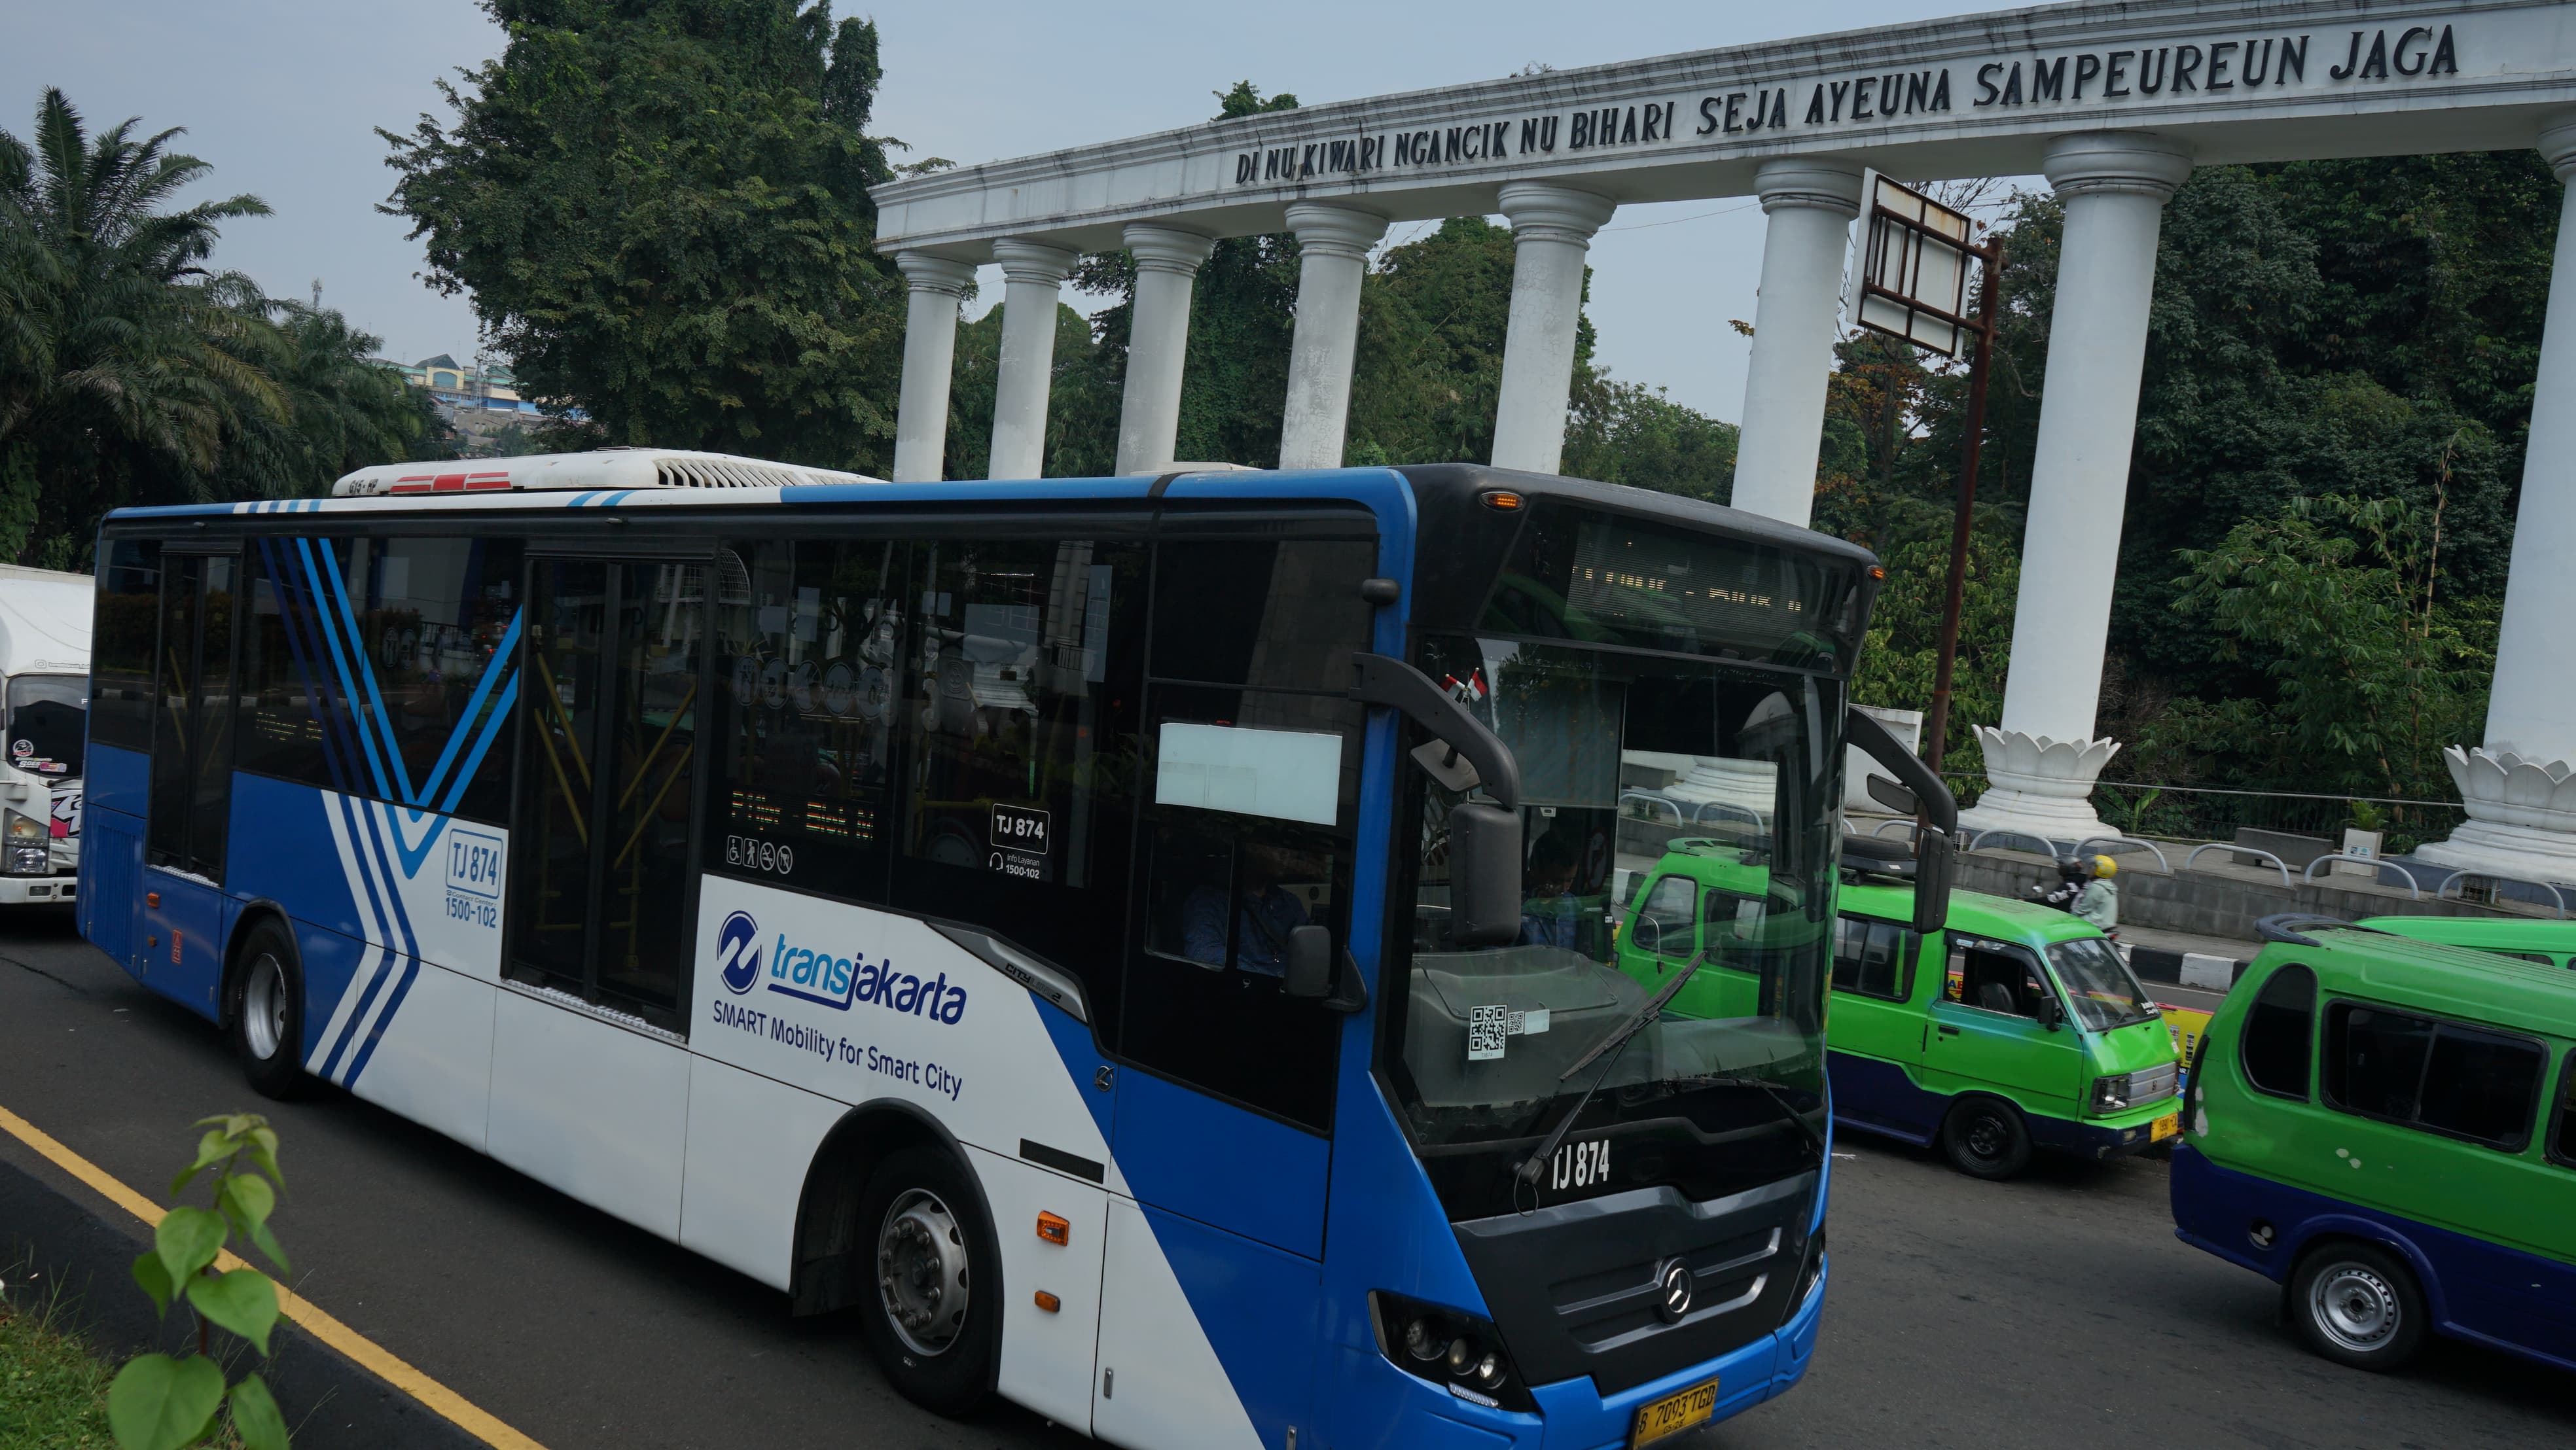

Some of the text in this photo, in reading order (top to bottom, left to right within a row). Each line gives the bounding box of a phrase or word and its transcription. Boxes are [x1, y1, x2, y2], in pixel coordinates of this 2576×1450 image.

[1236, 24, 2460, 184] DI NU KIWARI NGANCIK NU BIHARI SEJA AYEUNA SAMPEUREUN JAGA
[996, 815, 1045, 839] TJ 874
[453, 842, 497, 885] TJ 874
[1006, 864, 1040, 879] 1500-102
[1007, 853, 1017, 862] Info
[446, 896, 497, 928] 1500-102
[768, 933, 967, 1025] transjakarta
[713, 999, 962, 1101] SMART Mobility for Smart City
[1552, 1139, 1609, 1190] TJ 874
[1638, 1412, 1648, 1434] B
[1655, 1394, 1689, 1428] 7093
